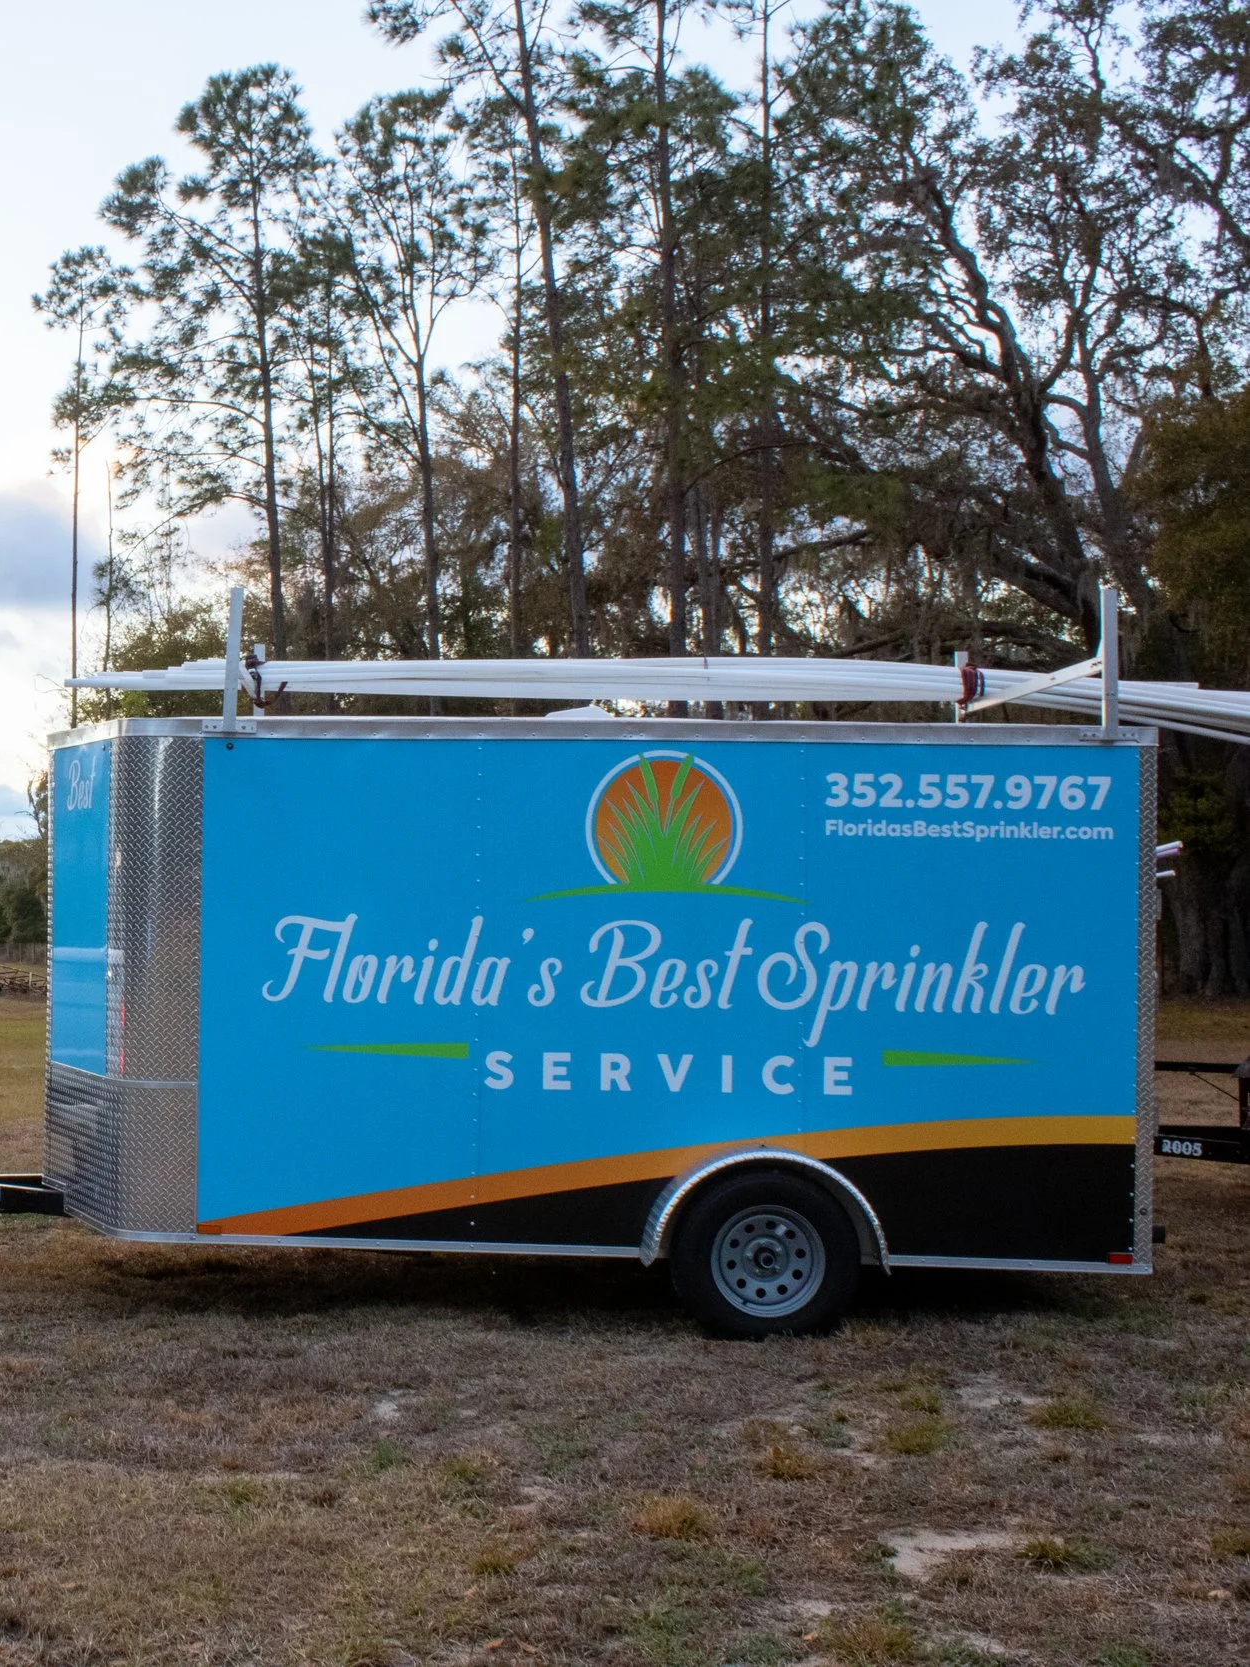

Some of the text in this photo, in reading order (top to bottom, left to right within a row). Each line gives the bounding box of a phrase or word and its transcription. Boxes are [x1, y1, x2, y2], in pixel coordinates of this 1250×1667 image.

[66, 755, 97, 811] Best
[826, 773, 1112, 810] 352.557.9767
[825, 819, 1114, 842] FloridasBestSprinkler.com
[262, 912, 1086, 1048] Florida's Best Sprinkler
[485, 1050, 853, 1095] SERVICE
